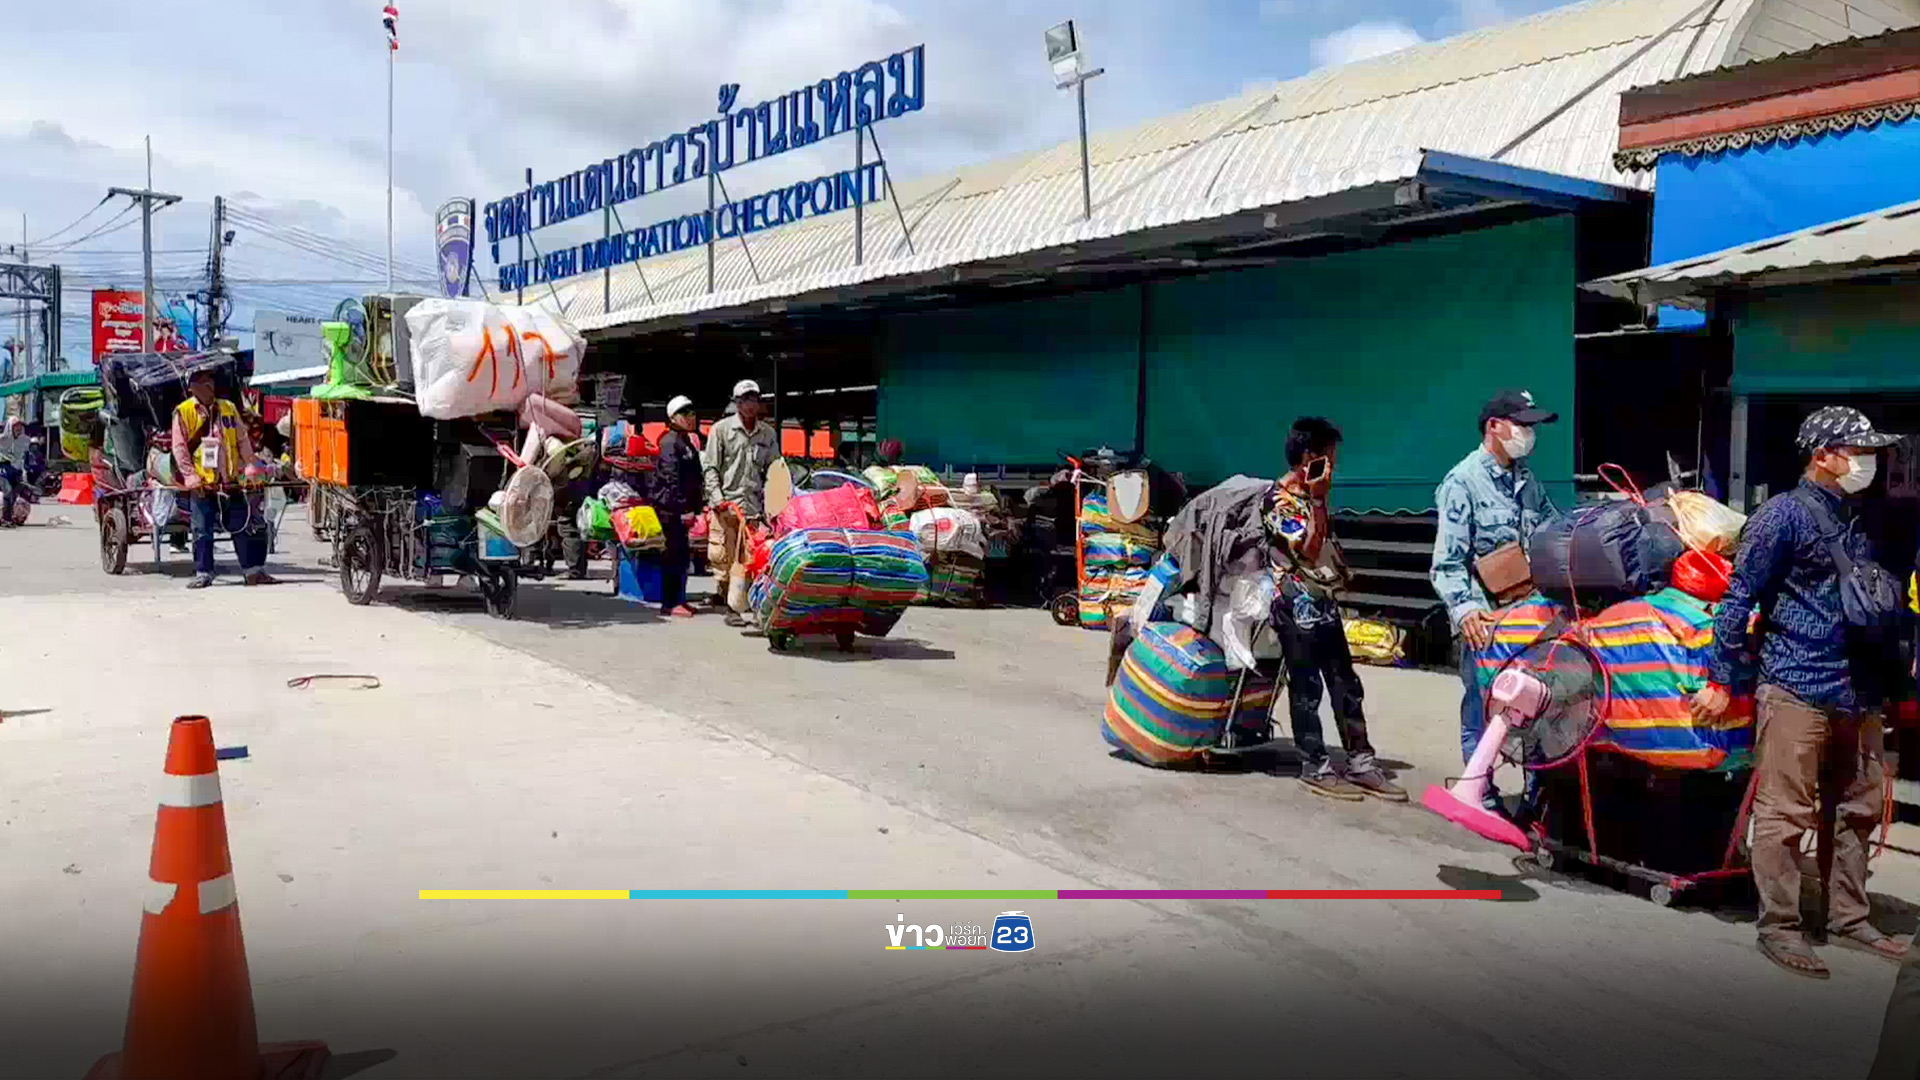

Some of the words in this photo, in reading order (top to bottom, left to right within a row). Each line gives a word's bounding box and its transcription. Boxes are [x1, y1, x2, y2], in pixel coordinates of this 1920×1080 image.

[484, 45, 925, 264] จุดผ่านแดนถาวรบ้านแหลม
[499, 261, 528, 293] BAN
[533, 246, 577, 284] LAEM
[581, 208, 714, 272] IMMIGRATION
[715, 165, 880, 240] CHECKPOINT
